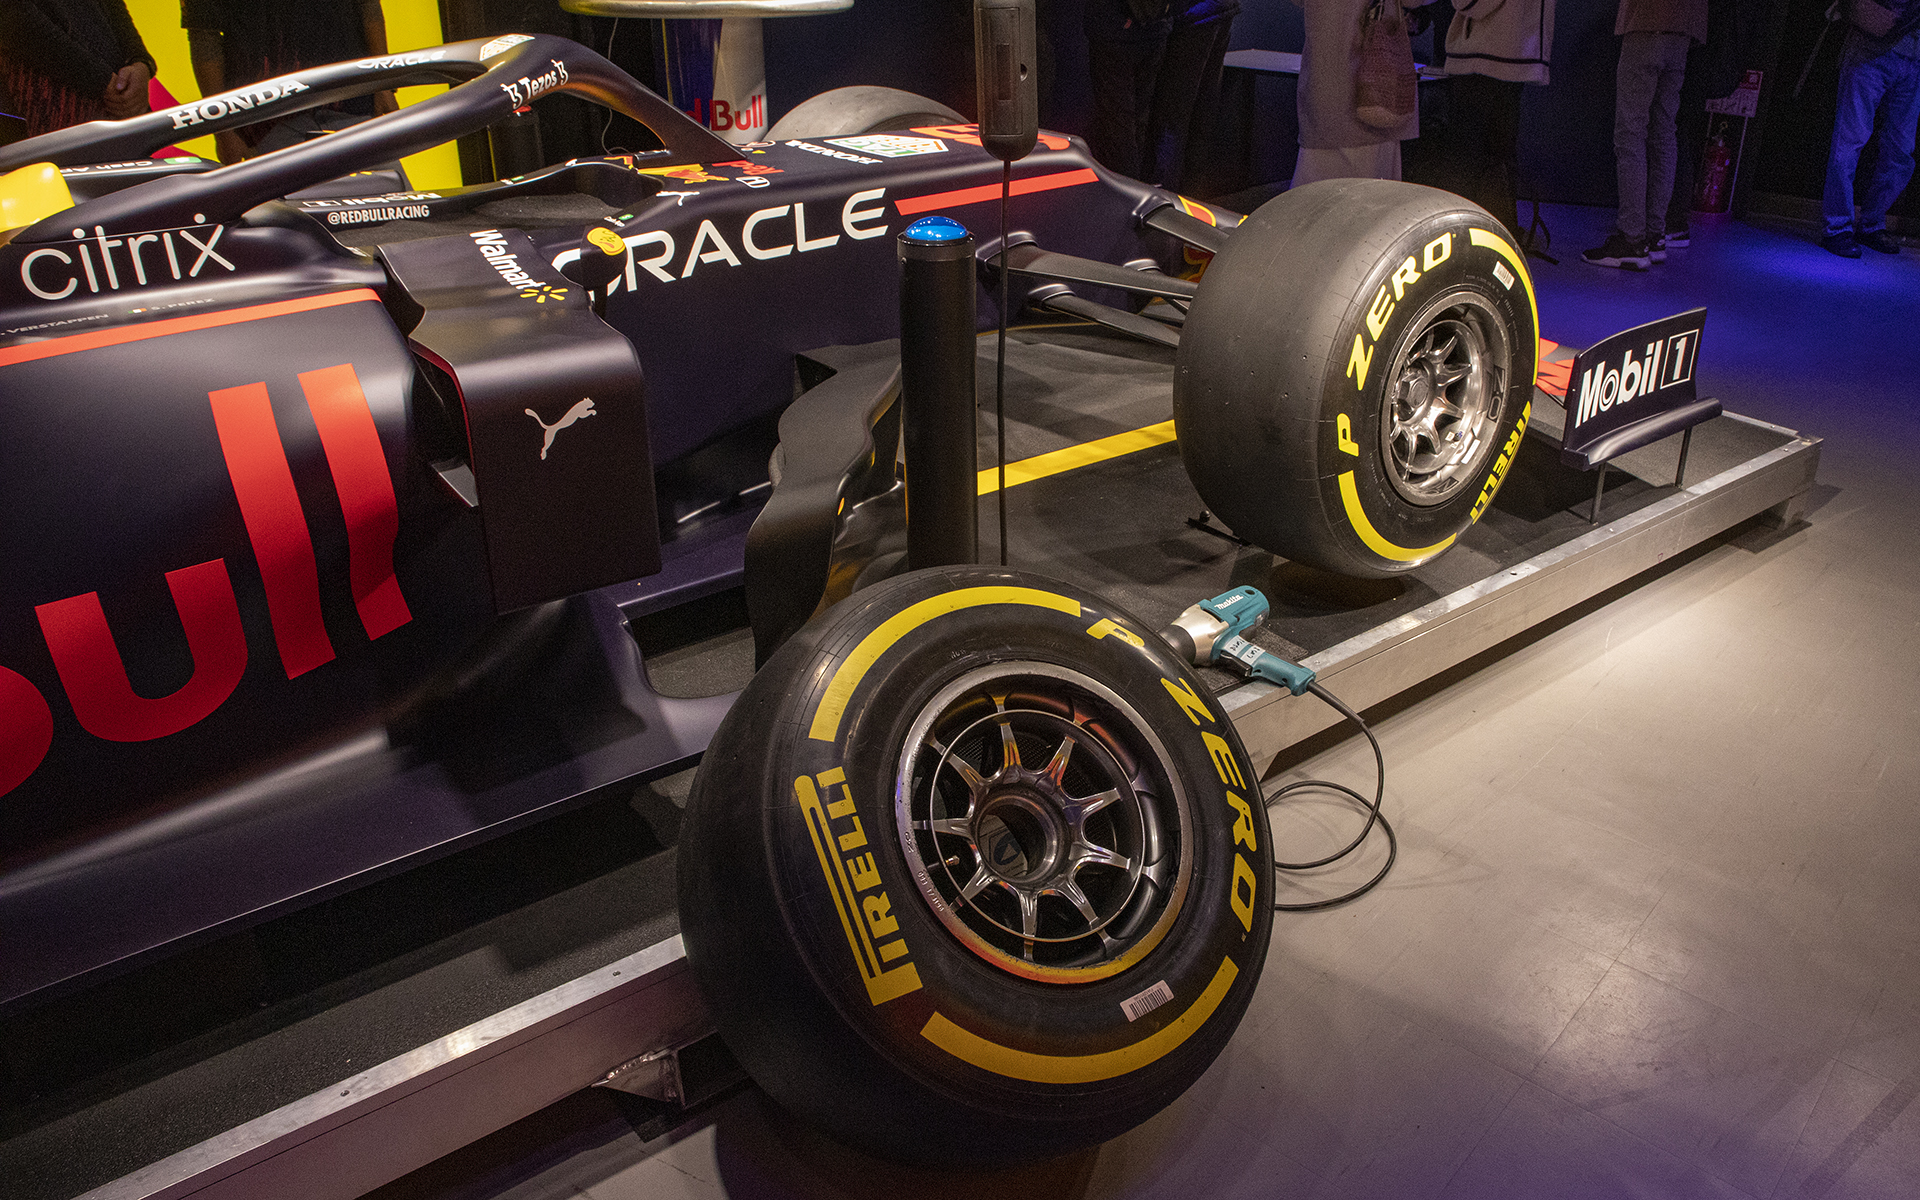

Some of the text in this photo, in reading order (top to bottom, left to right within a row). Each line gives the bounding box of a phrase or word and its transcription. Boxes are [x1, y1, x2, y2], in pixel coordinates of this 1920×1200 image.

[355, 50, 447, 69] ORACLE
[518, 69, 558, 100] Tezos
[167, 79, 310, 130] HONDA
[708, 94, 764, 132] Bull
[327, 205, 430, 225] @REDBULLRACING
[21, 213, 236, 300] citrix
[469, 229, 547, 290] Walmart
[168, 298, 215, 310] PEREZ
[1345, 231, 1452, 392] ZERO
[1574, 339, 1664, 430] Mobil
[1336, 412, 1360, 458] P
[0, 362, 414, 798] ull
[1213, 594, 1244, 611] Makita
[1085, 616, 1259, 934] P ZERO
[793, 765, 924, 1007] PIRELLI
